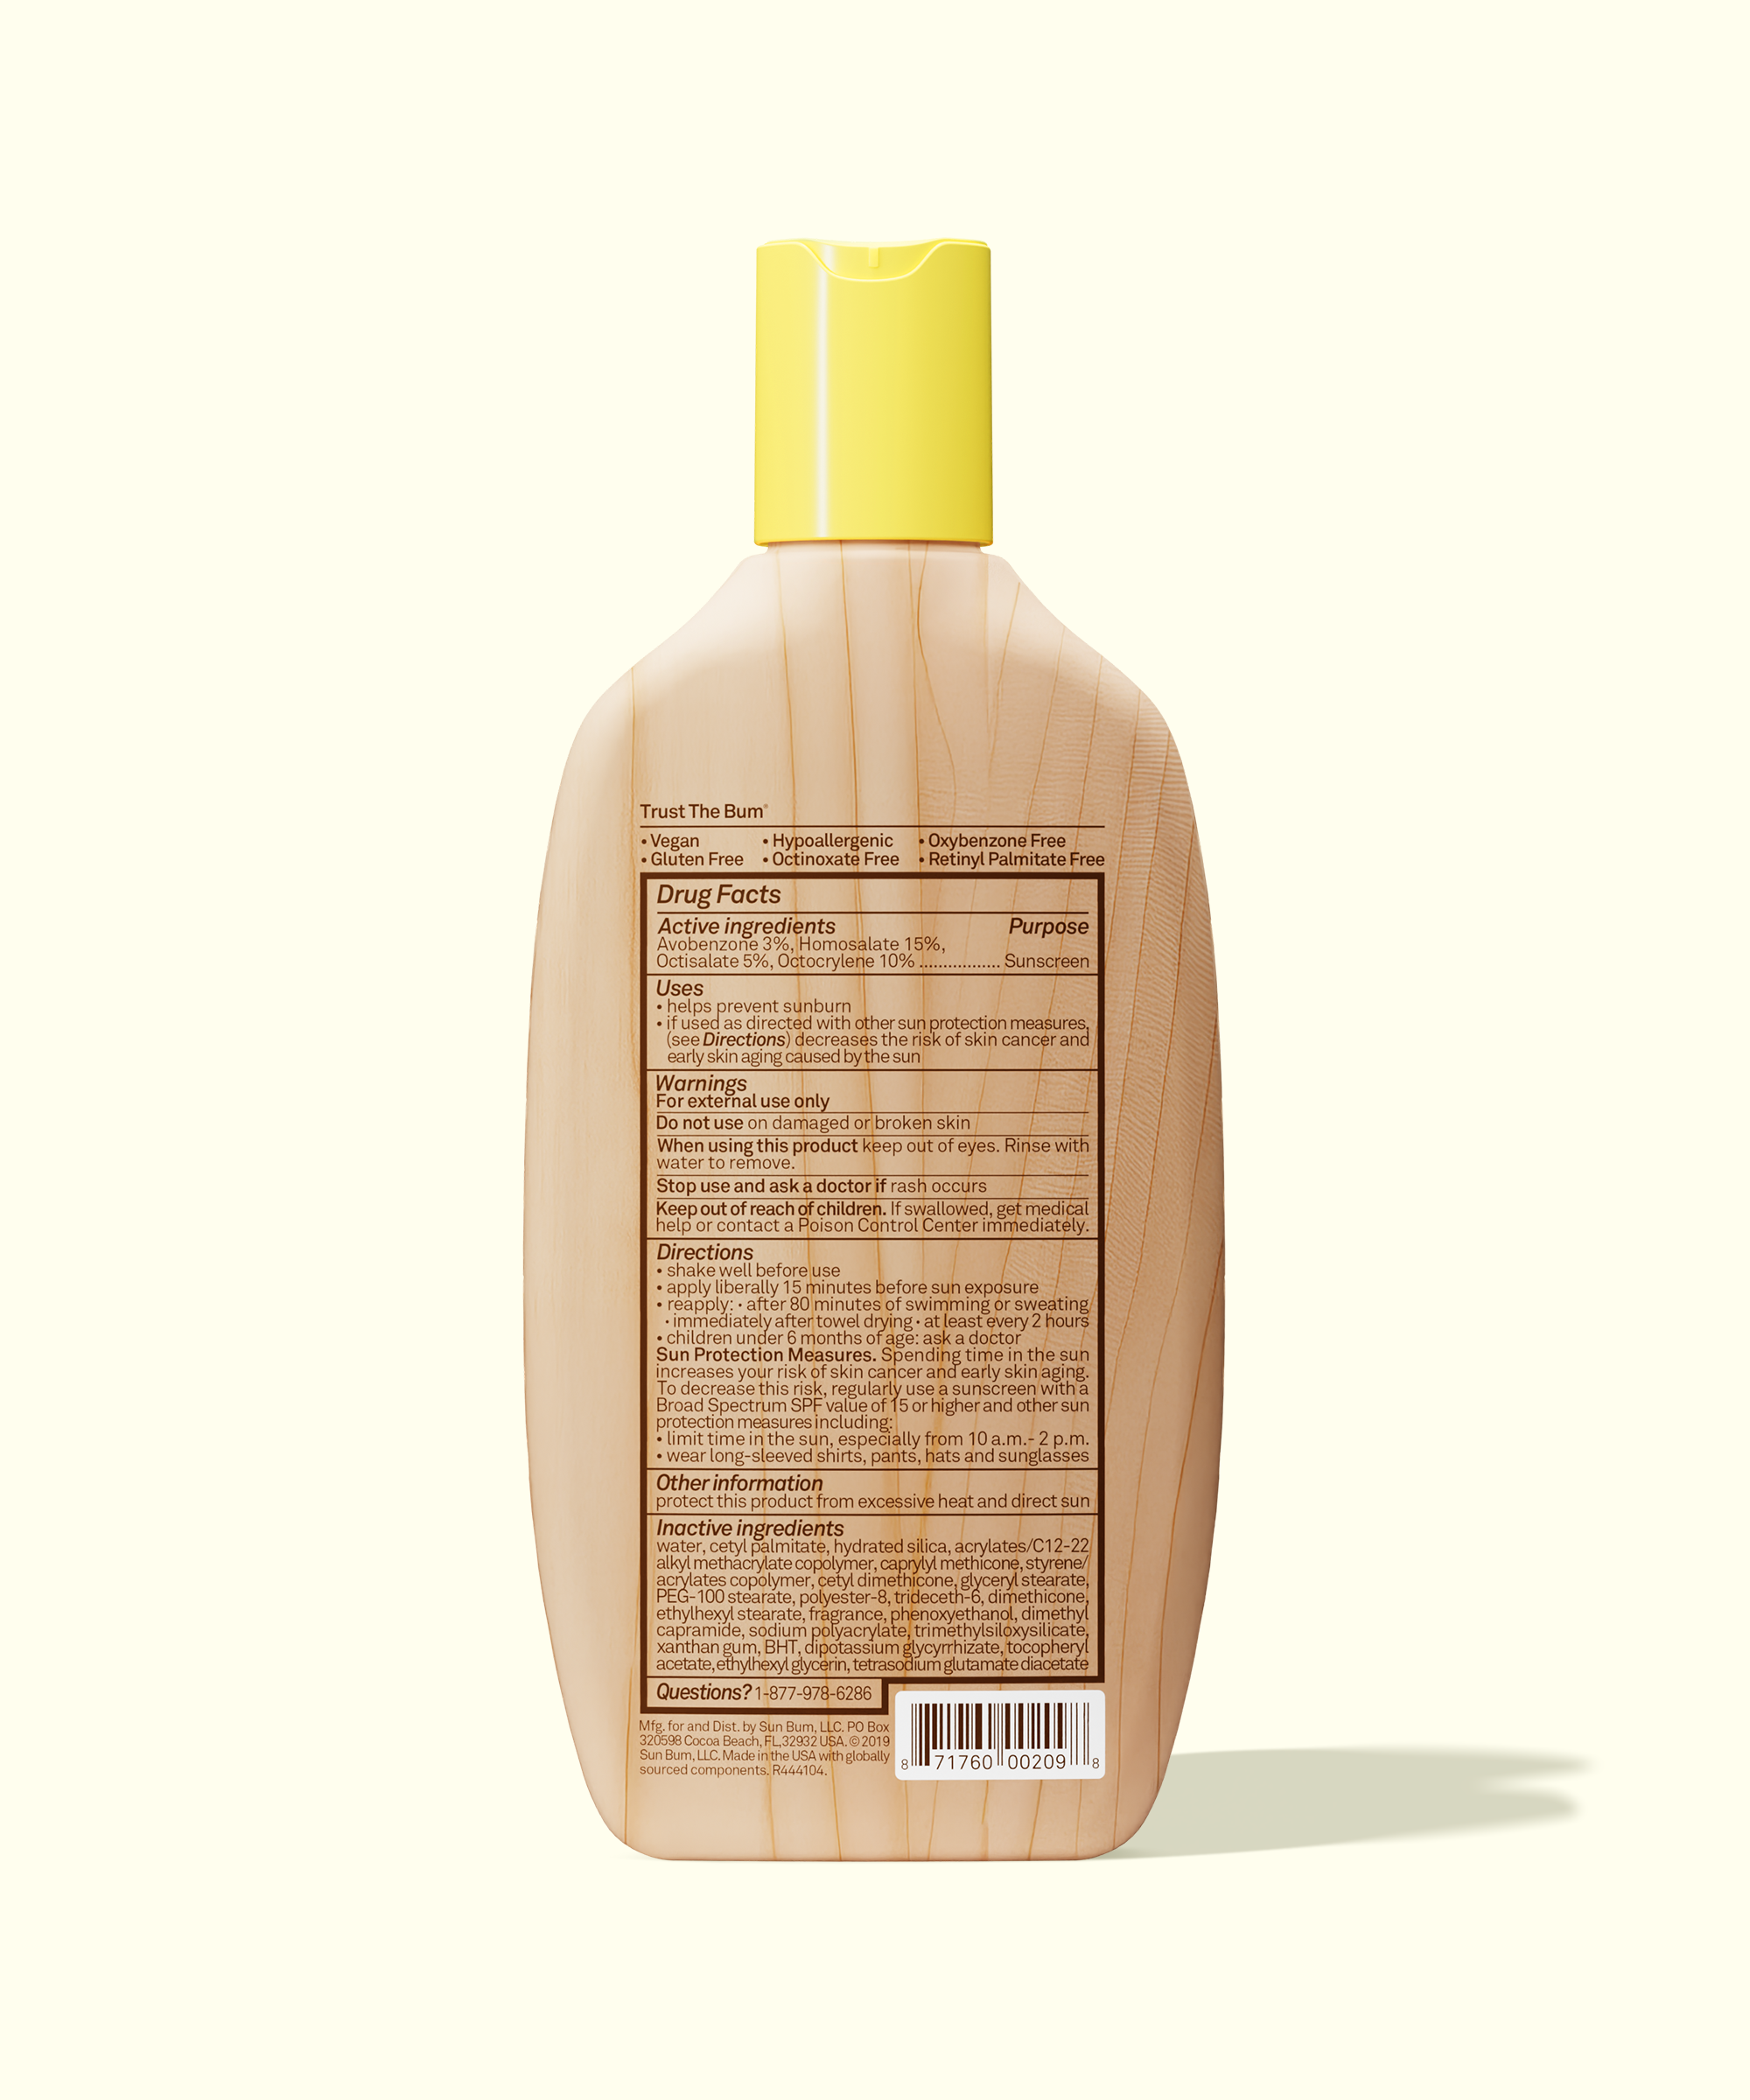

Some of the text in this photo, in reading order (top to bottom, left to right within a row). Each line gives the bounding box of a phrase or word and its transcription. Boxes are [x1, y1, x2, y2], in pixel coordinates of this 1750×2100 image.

[639, 803, 686, 818] Trust
[688, 803, 721, 818] The
[650, 832, 700, 851] Vegan
[773, 832, 893, 851] Hypoallergenic
[928, 832, 1067, 851] Oxybenzone Free
[650, 850, 744, 865] Gluten Free
[772, 850, 900, 865] Octinoxate Free
[929, 850, 1105, 869] Retinyl Palmitate Free
[656, 884, 781, 909] Drug Facts
[657, 917, 836, 939] Active ingredients
[1008, 917, 1089, 939] Purpose
[656, 935, 946, 955] Avobenzone 3%, Homosalate 15%,
[656, 953, 1089, 972] Octisalate 5%, Octocrylene 10% Sunscreen
[656, 979, 704, 996] Uses
[668, 998, 851, 1016] helps prevent sunburn
[656, 1074, 747, 1096] Warnings
[656, 1093, 830, 1112] For external use only
[656, 1115, 970, 1133] Do not use on damaged or broken skin
[656, 1155, 795, 1169] water to remove.
[656, 1178, 987, 1196] Stop use and ask a doctor if rash occurs
[656, 1200, 1089, 1219] Keep out of reach of children. If swallowed, get medical
[656, 1242, 754, 1260] Directions
[667, 1262, 841, 1277] shake well before use
[667, 1279, 1040, 1298] apply liberally 15 minutes before sun exposure
[656, 1347, 1089, 1365] Sun Protection Measures. Spending time in the sun
[666, 1447, 1089, 1466] wear long-sleeved shirts, pants, hats and sunglasses
[656, 1474, 823, 1491] Other information
[656, 1493, 1090, 1511] protect this product from excessive heat and direct sun
[656, 1519, 844, 1541] Inactive ingredients
[656, 1537, 1089, 1557] water, cetyl palmitate, hydrated silica, acrylates/C12-22
[656, 1606, 1089, 1624] ethylhexyl stearate, fragrance, phenoxyethanol, dimethyl
[655, 1656, 1089, 1675] acetate, ethylhexyl glycerin, tetrasodium glutamate diacetate
[656, 1682, 872, 1702] Questions? 1-877-978-6286
[639, 1720, 890, 1735] Mfg. for and Dist. by Sun Bum, LLC. PO Box
[640, 1734, 682, 1746] 320598
[683, 1734, 720, 1746] Cocoa
[723, 1734, 762, 1750] Beach,
[819, 1734, 848, 1746] USA.
[861, 1734, 891, 1746] 2019
[640, 1763, 828, 1779] sourced components. R444104.
[900, 1754, 1100, 1770] 8 71760 00209 8
